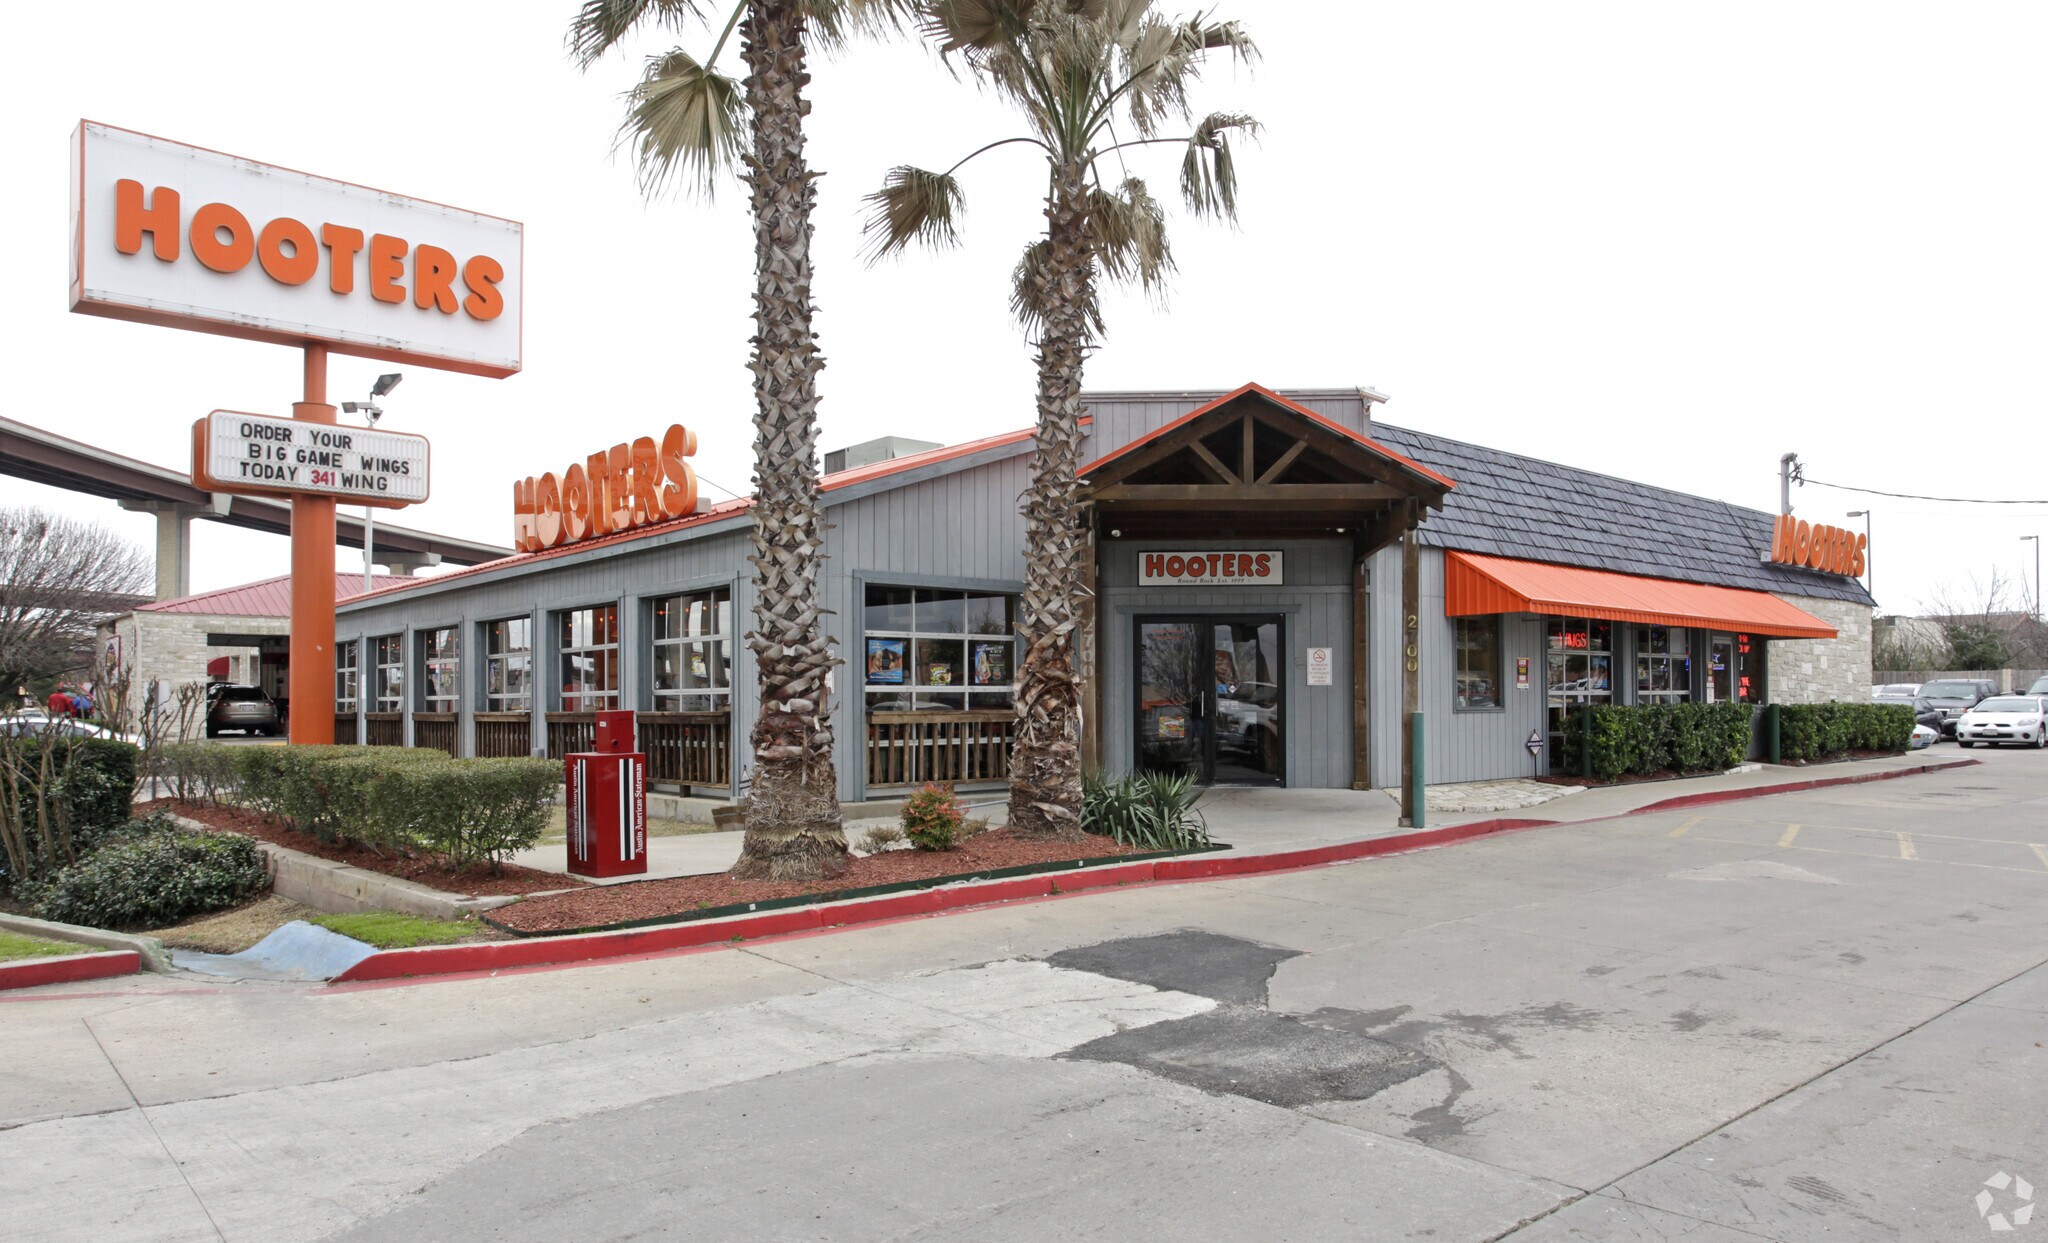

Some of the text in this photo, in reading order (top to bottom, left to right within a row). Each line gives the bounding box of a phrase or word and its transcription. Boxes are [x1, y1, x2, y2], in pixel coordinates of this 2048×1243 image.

[114, 178, 505, 321] HOOTERS
[240, 422, 352, 449] ORDER YOUR
[249, 443, 410, 475] BIG GAME WINGS
[240, 461, 388, 491] TODAY 341 WING
[513, 423, 698, 553] HOOTERS
[1772, 513, 1867, 577] HOOTERS
[1145, 554, 1271, 577] HOOTERS
